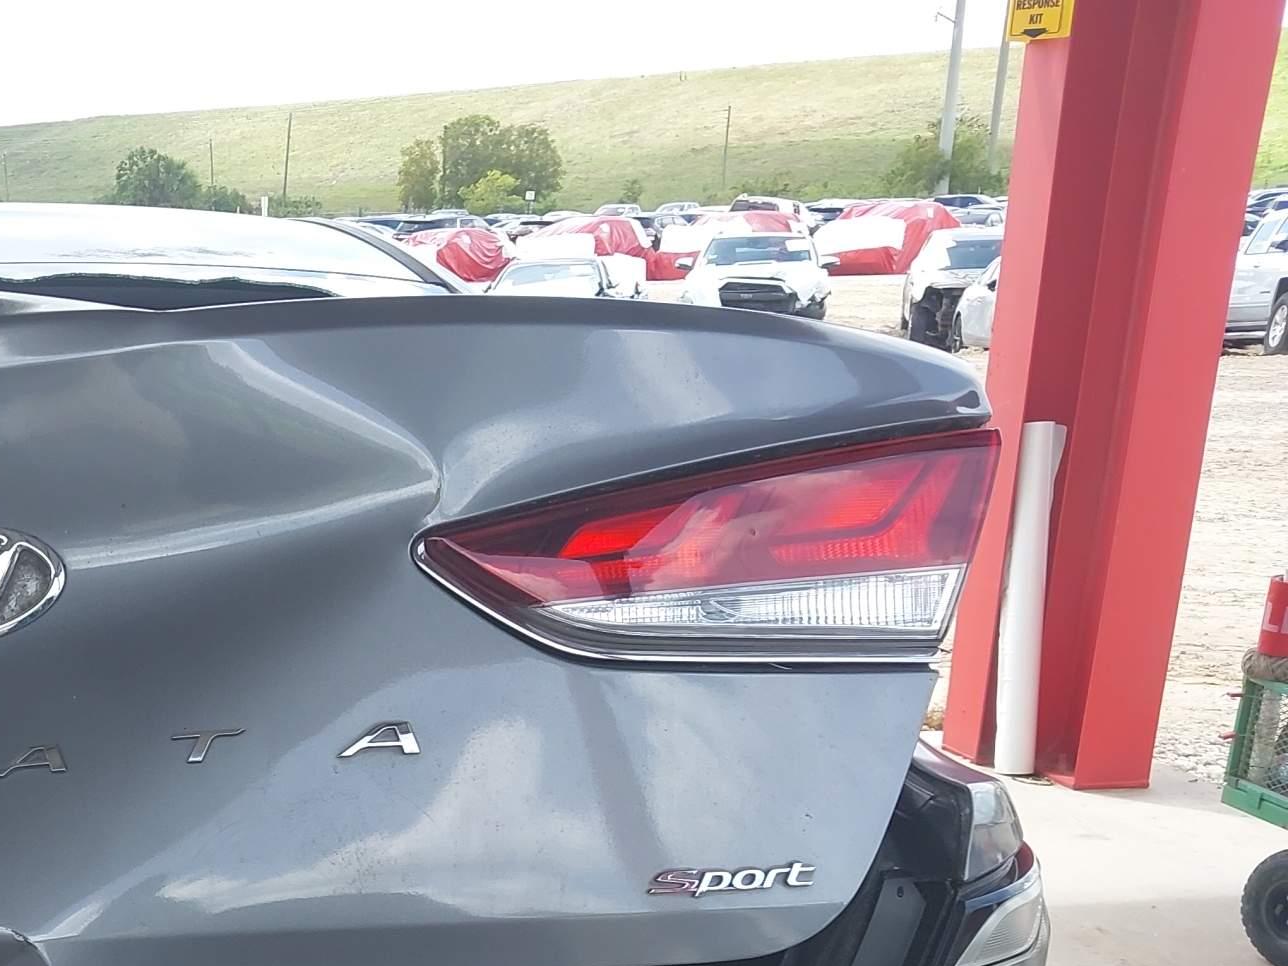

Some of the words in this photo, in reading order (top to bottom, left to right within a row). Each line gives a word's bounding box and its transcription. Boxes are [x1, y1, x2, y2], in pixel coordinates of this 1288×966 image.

[1016, 0, 1060, 10] RESPONSE
[1028, 13, 1044, 25] KIT
[647, 861, 816, 898] Sport
